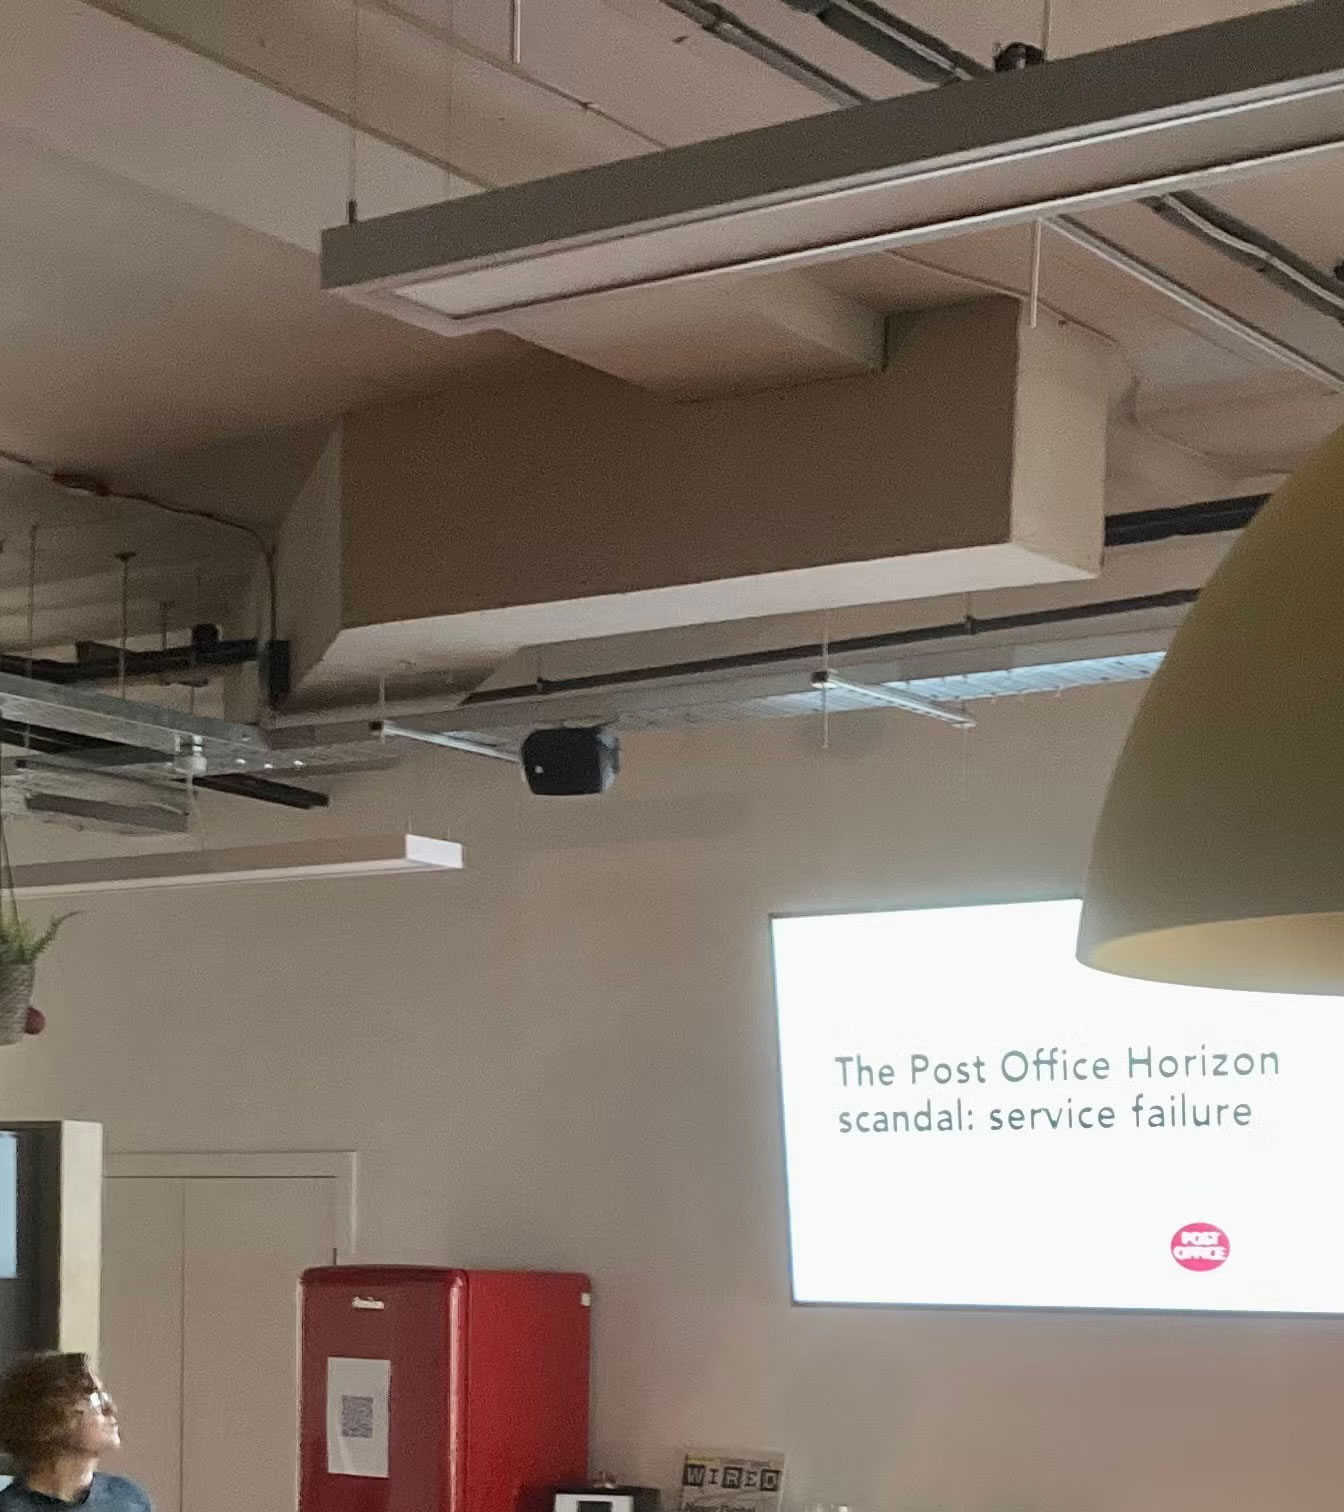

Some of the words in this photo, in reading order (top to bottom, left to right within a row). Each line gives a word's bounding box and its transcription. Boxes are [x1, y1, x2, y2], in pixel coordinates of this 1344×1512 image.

[834, 1052, 895, 1087] The
[910, 1053, 986, 1085] Post
[1000, 1047, 1110, 1083] Office
[1127, 1043, 1279, 1079] Horizon
[838, 1097, 974, 1134] scandal:
[989, 1097, 1116, 1131] service
[1131, 1092, 1252, 1128] failure
[1181, 1231, 1221, 1246] POST
[1173, 1246, 1228, 1261] OFFICE
[682, 1464, 781, 1491] WIRED
